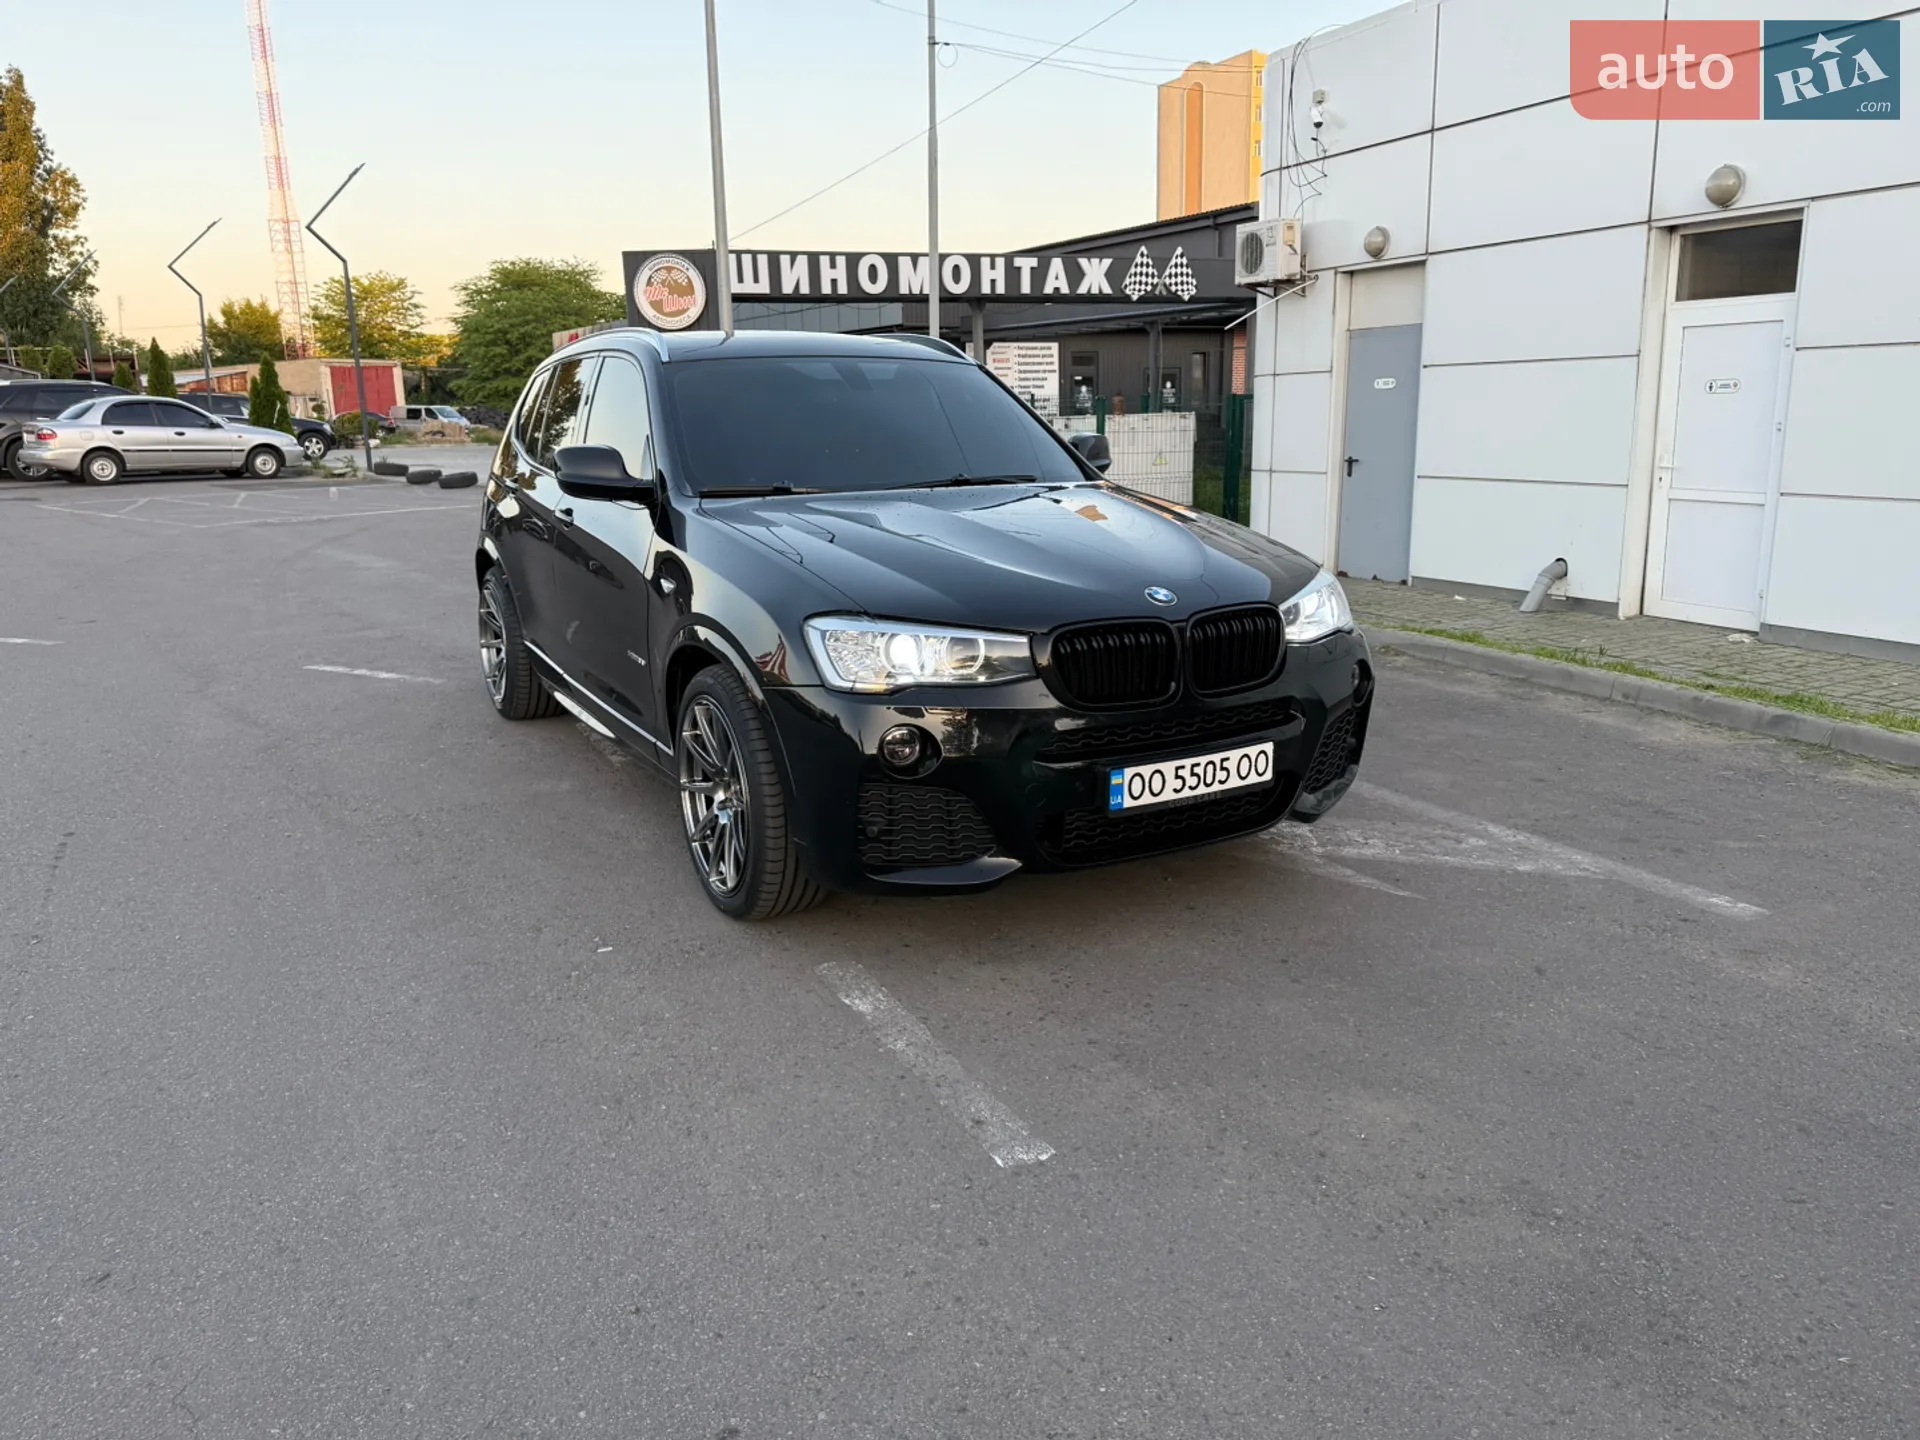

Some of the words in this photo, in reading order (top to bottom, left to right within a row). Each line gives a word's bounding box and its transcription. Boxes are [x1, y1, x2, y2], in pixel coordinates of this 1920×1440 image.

[728, 253, 1113, 295] ШИНОМОНТАЖ
[1172, 757, 1231, 793] 5505
[1110, 796, 1123, 805] UA
